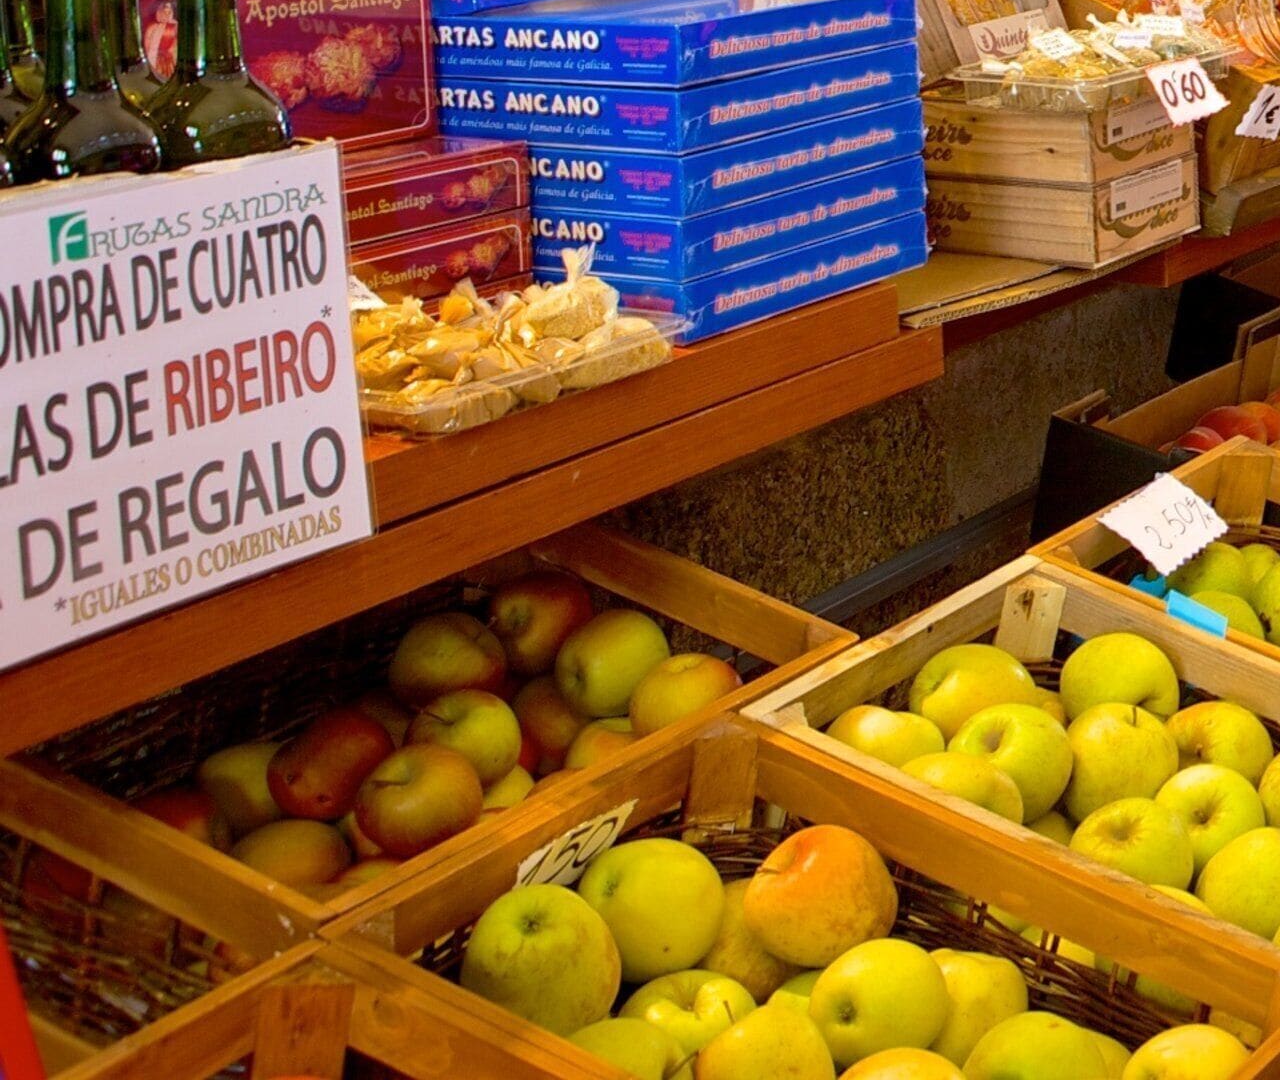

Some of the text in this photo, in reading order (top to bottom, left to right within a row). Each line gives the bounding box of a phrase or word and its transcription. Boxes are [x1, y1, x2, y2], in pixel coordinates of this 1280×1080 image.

[430, 25, 600, 51] ARTAS ANCANO
[710, 35, 770, 59] Deliciosa
[772, 30, 803, 47] tarta
[806, 21, 820, 40] de
[528, 57, 562, 71] famosa
[563, 58, 575, 70] de
[438, 87, 600, 116] RTAS ANCANO
[710, 98, 771, 125] Deliciosa
[773, 92, 804, 111] tarta
[807, 82, 821, 102] de
[529, 121, 562, 135] famosa
[563, 123, 575, 135] de
[530, 157, 604, 182] CANO
[712, 163, 774, 190] Deliciosa
[776, 150, 808, 171] tarta
[810, 142, 826, 161] de
[201, 183, 329, 231] SANDRA
[378, 192, 434, 214] Santiago
[535, 184, 566, 198] famosa
[567, 186, 579, 199] de
[531, 217, 605, 242] CANO
[713, 222, 776, 253] Deliciosa
[777, 210, 810, 232] tarta
[811, 203, 828, 222] de
[131, 246, 182, 332] DE
[187, 213, 329, 316] CUATRO
[381, 263, 438, 286] Santiago
[714, 282, 777, 315] Deliciosa
[779, 271, 811, 293] tarta
[812, 261, 829, 280] de
[86, 369, 154, 462] DE
[17, 425, 347, 602] DE REGALO
[176, 557, 194, 586] O
[199, 506, 343, 579] COMBINADAS
